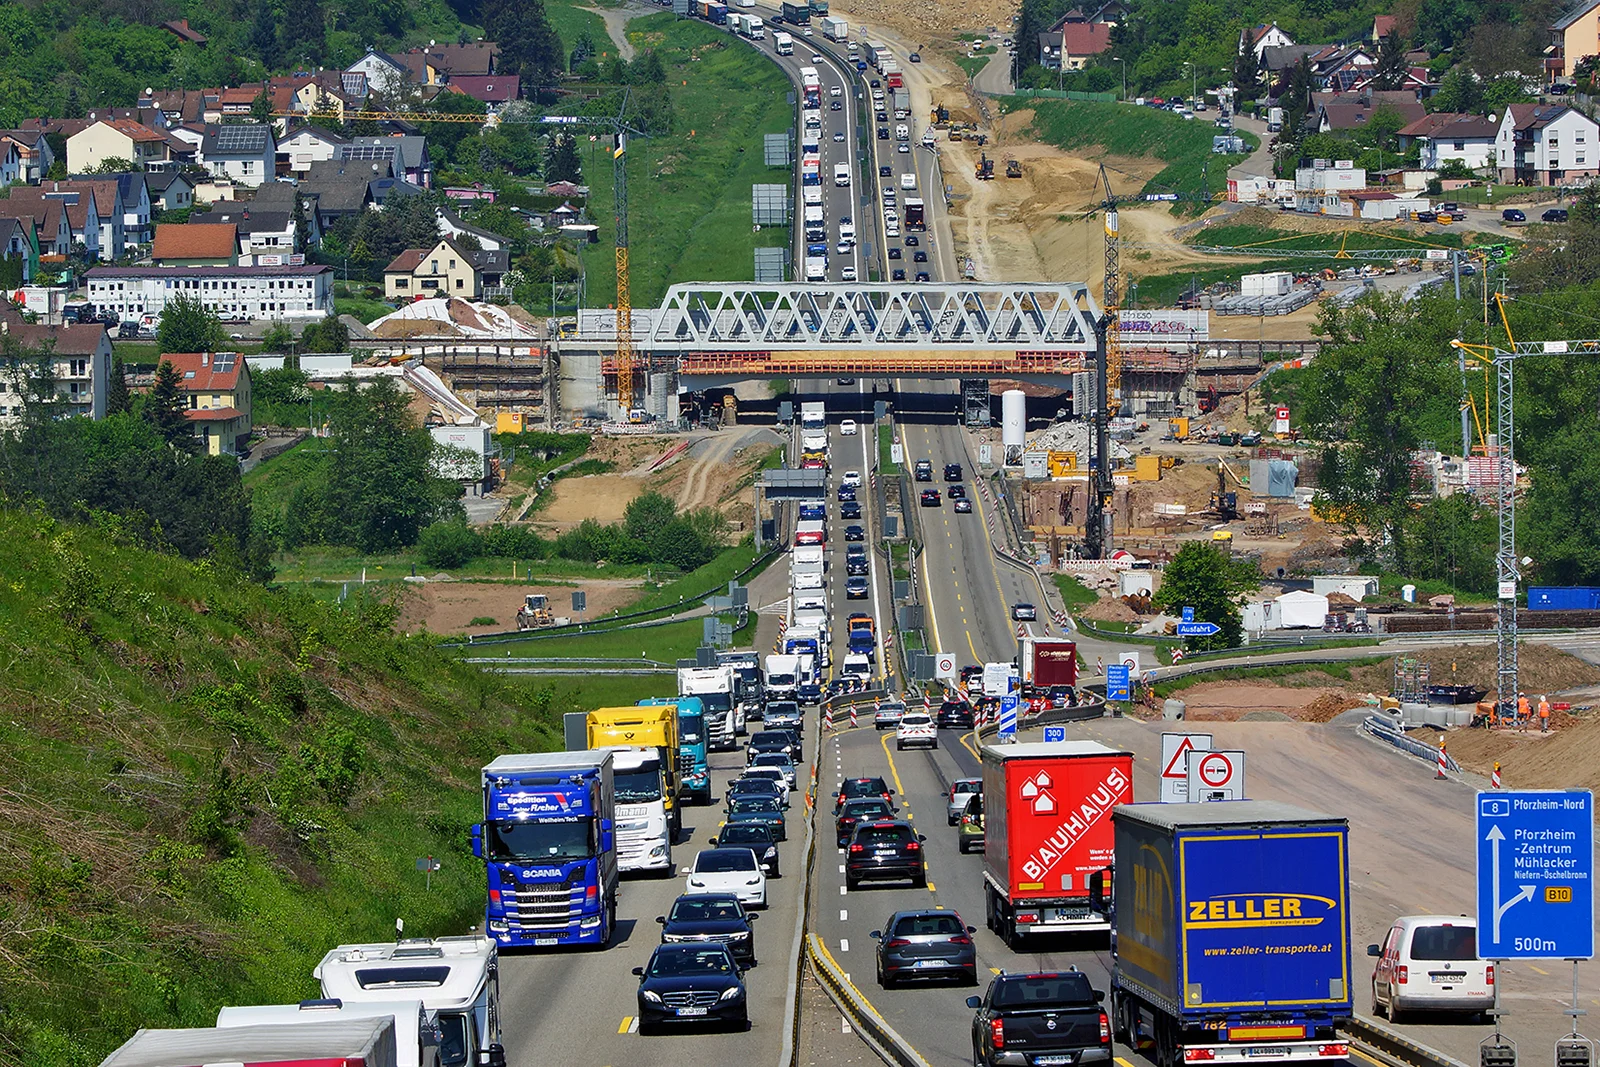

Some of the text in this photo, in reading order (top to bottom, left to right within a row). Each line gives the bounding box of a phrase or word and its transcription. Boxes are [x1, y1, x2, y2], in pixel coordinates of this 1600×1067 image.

[1180, 625, 1211, 633] Ausfahrt
[1047, 729, 1062, 737] 300
[507, 796, 547, 805] Spedition
[1513, 799, 1585, 810] Pforzheim-Nord
[530, 803, 559, 812] Fischer
[1491, 803, 1499, 813] 8
[1022, 772, 1125, 879] BAUHAUS
[1514, 829, 1576, 840] Pforzheim
[1514, 843, 1572, 854] -Zentrum
[1514, 857, 1577, 868] Mühlacker
[522, 868, 563, 878] SCANIA
[1514, 870, 1588, 879] Niefern-Öschelbronn
[1549, 890, 1568, 900] B10
[1189, 898, 1302, 920] ZELLER
[1514, 937, 1556, 951] 500m
[1203, 1021, 1227, 1030] 782
